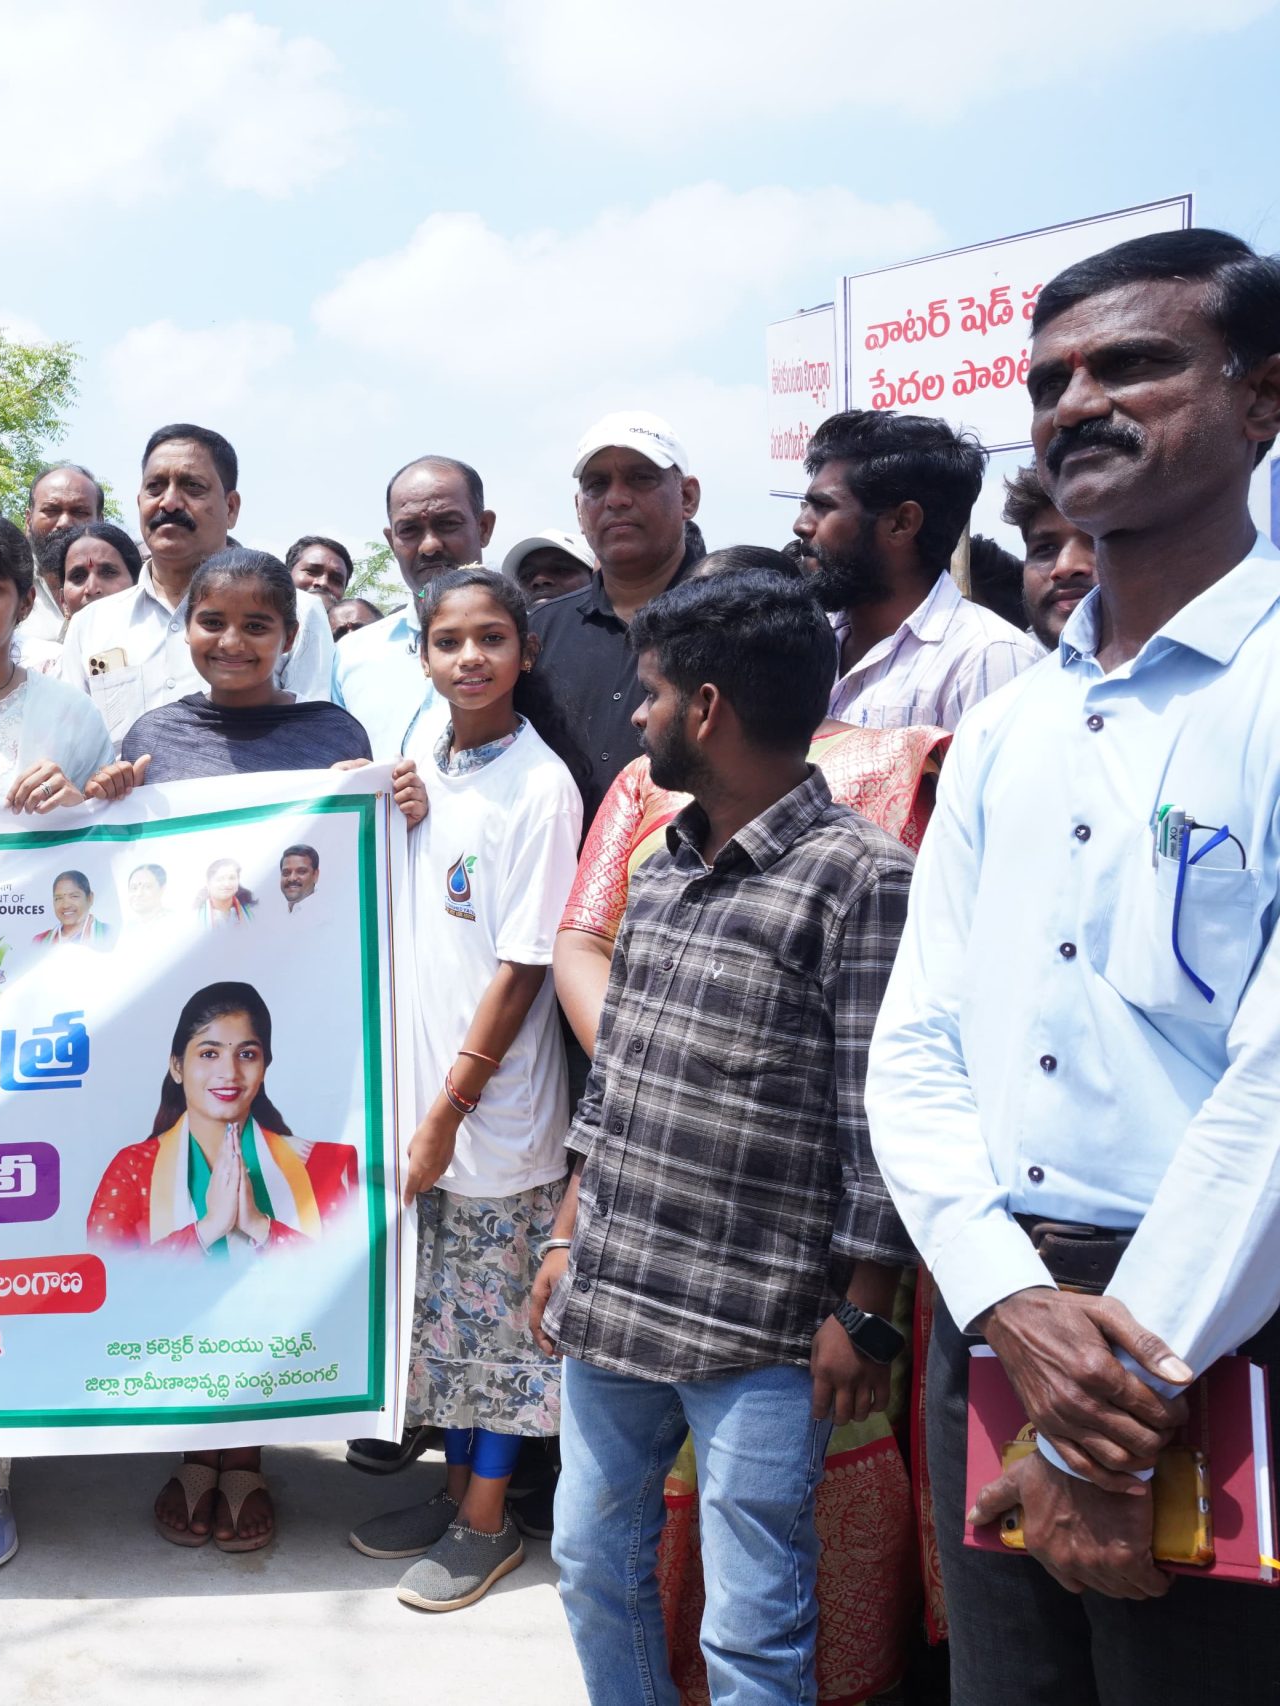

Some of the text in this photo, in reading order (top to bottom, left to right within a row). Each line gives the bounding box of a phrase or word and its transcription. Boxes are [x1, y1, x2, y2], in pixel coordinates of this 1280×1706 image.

[864, 299, 950, 350] వాటర్
[958, 285, 1014, 336] షెడ్
[869, 368, 945, 410] పేదల
[11, 894, 25, 904] OF
[107, 1340, 142, 1360] జిల్లా
[146, 1335, 194, 1361] కలెక్టర్
[198, 1337, 263, 1354] మరియు
[85, 1375, 121, 1396] జిల్లా
